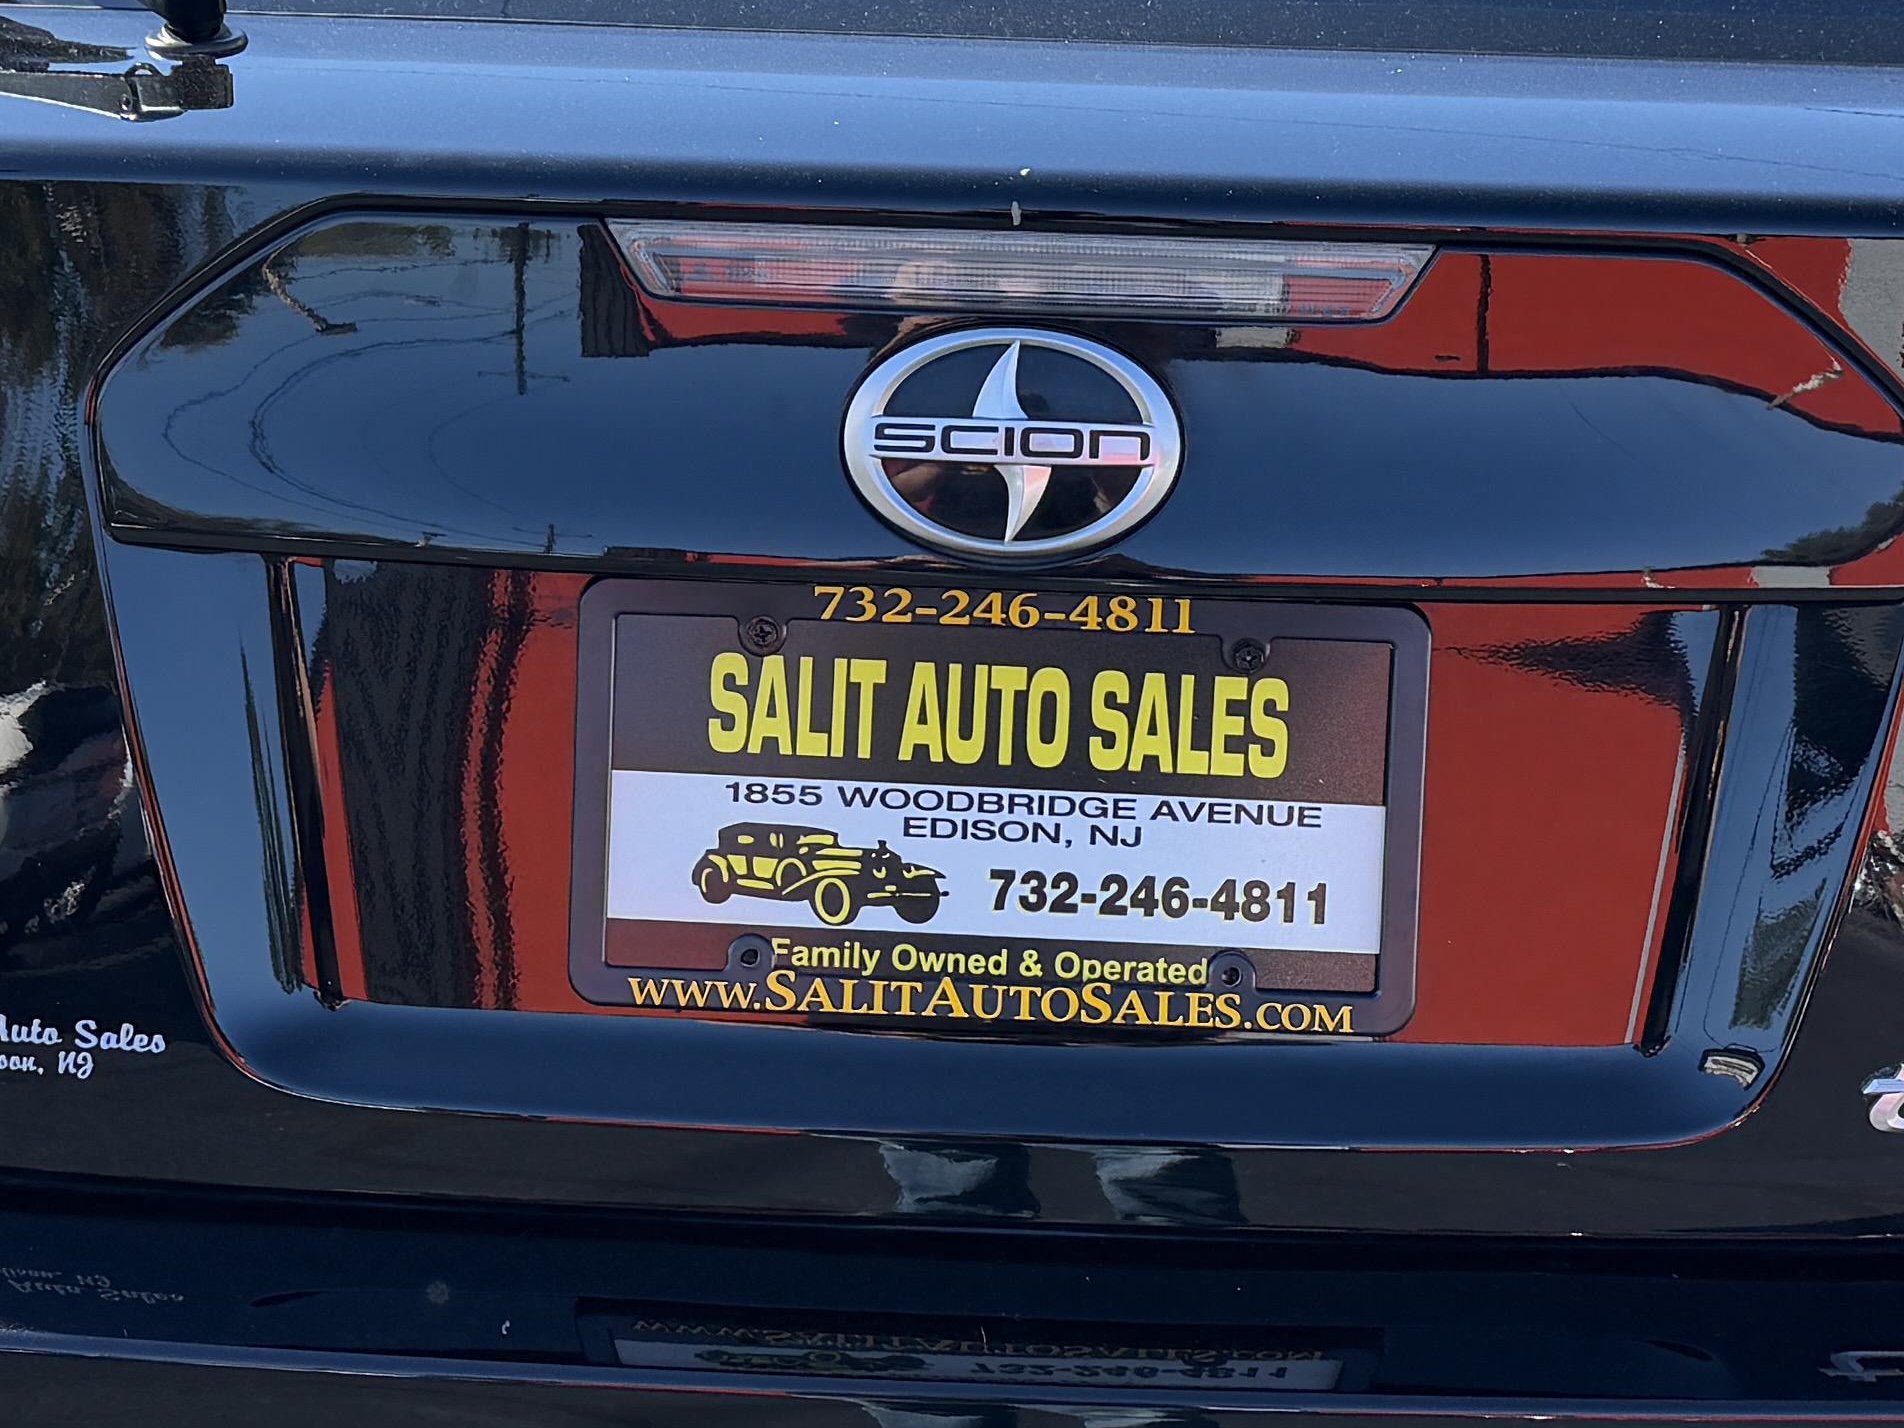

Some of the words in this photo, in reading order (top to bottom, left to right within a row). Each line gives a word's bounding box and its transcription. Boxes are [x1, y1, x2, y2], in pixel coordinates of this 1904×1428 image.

[873, 422, 1151, 462] SCION
[812, 586, 1195, 635] 732-246-4811
[708, 651, 886, 760] SALIT
[898, 662, 1069, 768] AUTO
[1089, 670, 1290, 779] SALES
[725, 782, 823, 808] 1855
[837, 786, 1137, 820] WOODBRIDGE
[1150, 800, 1322, 828] AVENUE
[902, 815, 1073, 847] EDISON,
[1090, 823, 1142, 848] NJ
[988, 870, 1328, 925] 732-246-4811
[771, 937, 880, 976] Family
[891, 944, 1011, 976] Owned
[1020, 948, 1043, 978] &
[1055, 950, 1208, 985] Operated
[75, 1020, 166, 1053] Sales
[58, 1051, 94, 1079] NJ
